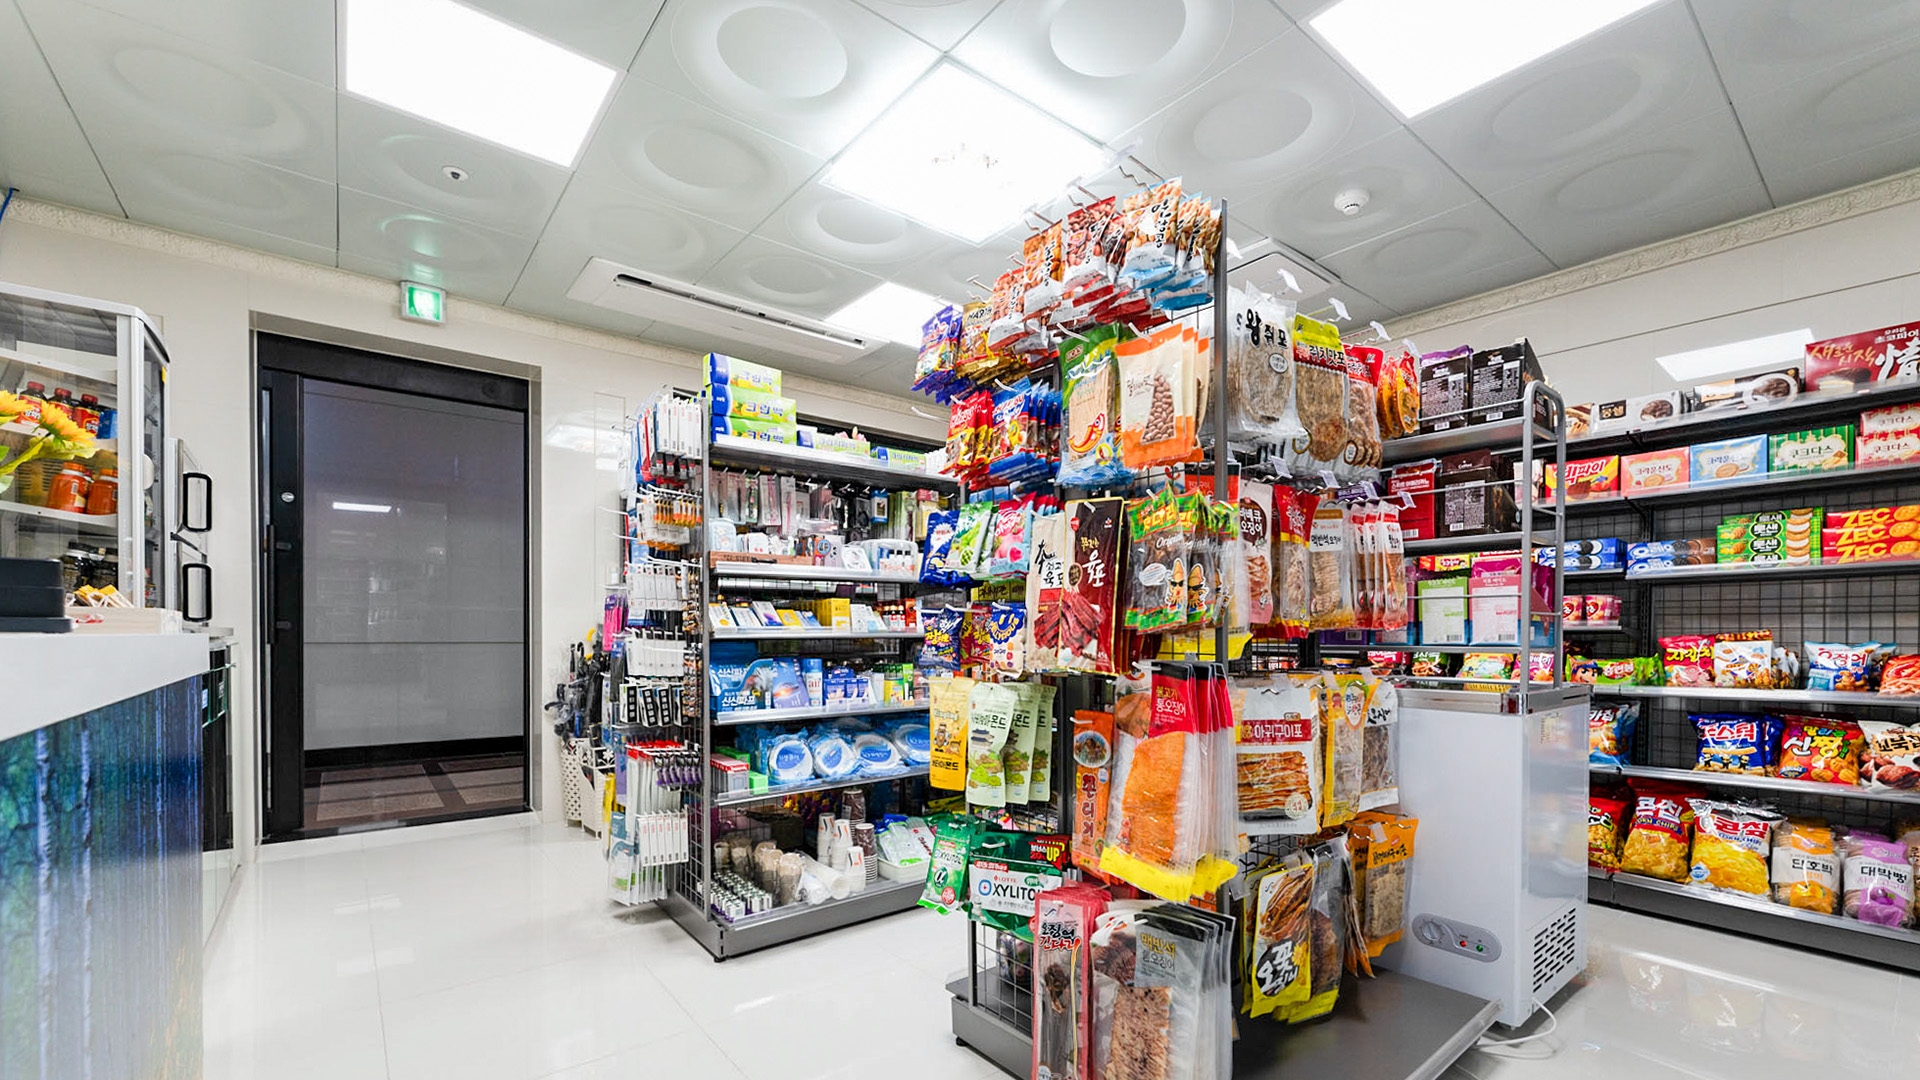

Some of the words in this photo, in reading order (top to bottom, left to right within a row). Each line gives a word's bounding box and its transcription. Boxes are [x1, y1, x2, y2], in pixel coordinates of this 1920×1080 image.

[1788, 445, 1833, 458] 쿠크다스
[1874, 442, 1911, 453] 쿠크다스
[1841, 508, 1891, 528] ZEC
[1836, 524, 1886, 546] ZEC
[1836, 543, 1888, 564] ZEC
[1666, 645, 1715, 663] 자갈치
[1156, 698, 1187, 717] 통오징어
[1589, 709, 1614, 722] 카칩
[1254, 723, 1303, 739] 아귀구이포
[1783, 734, 1844, 759] 신짱
[1636, 796, 1683, 824] 콘칩
[1713, 816, 1770, 839] 콘칩
[1046, 847, 1060, 862] UP
[1791, 857, 1833, 876] 단호박
[992, 882, 1041, 902] XYLITO
[1041, 921, 1075, 938] 오징어
[1140, 932, 1176, 958] 맥반석
